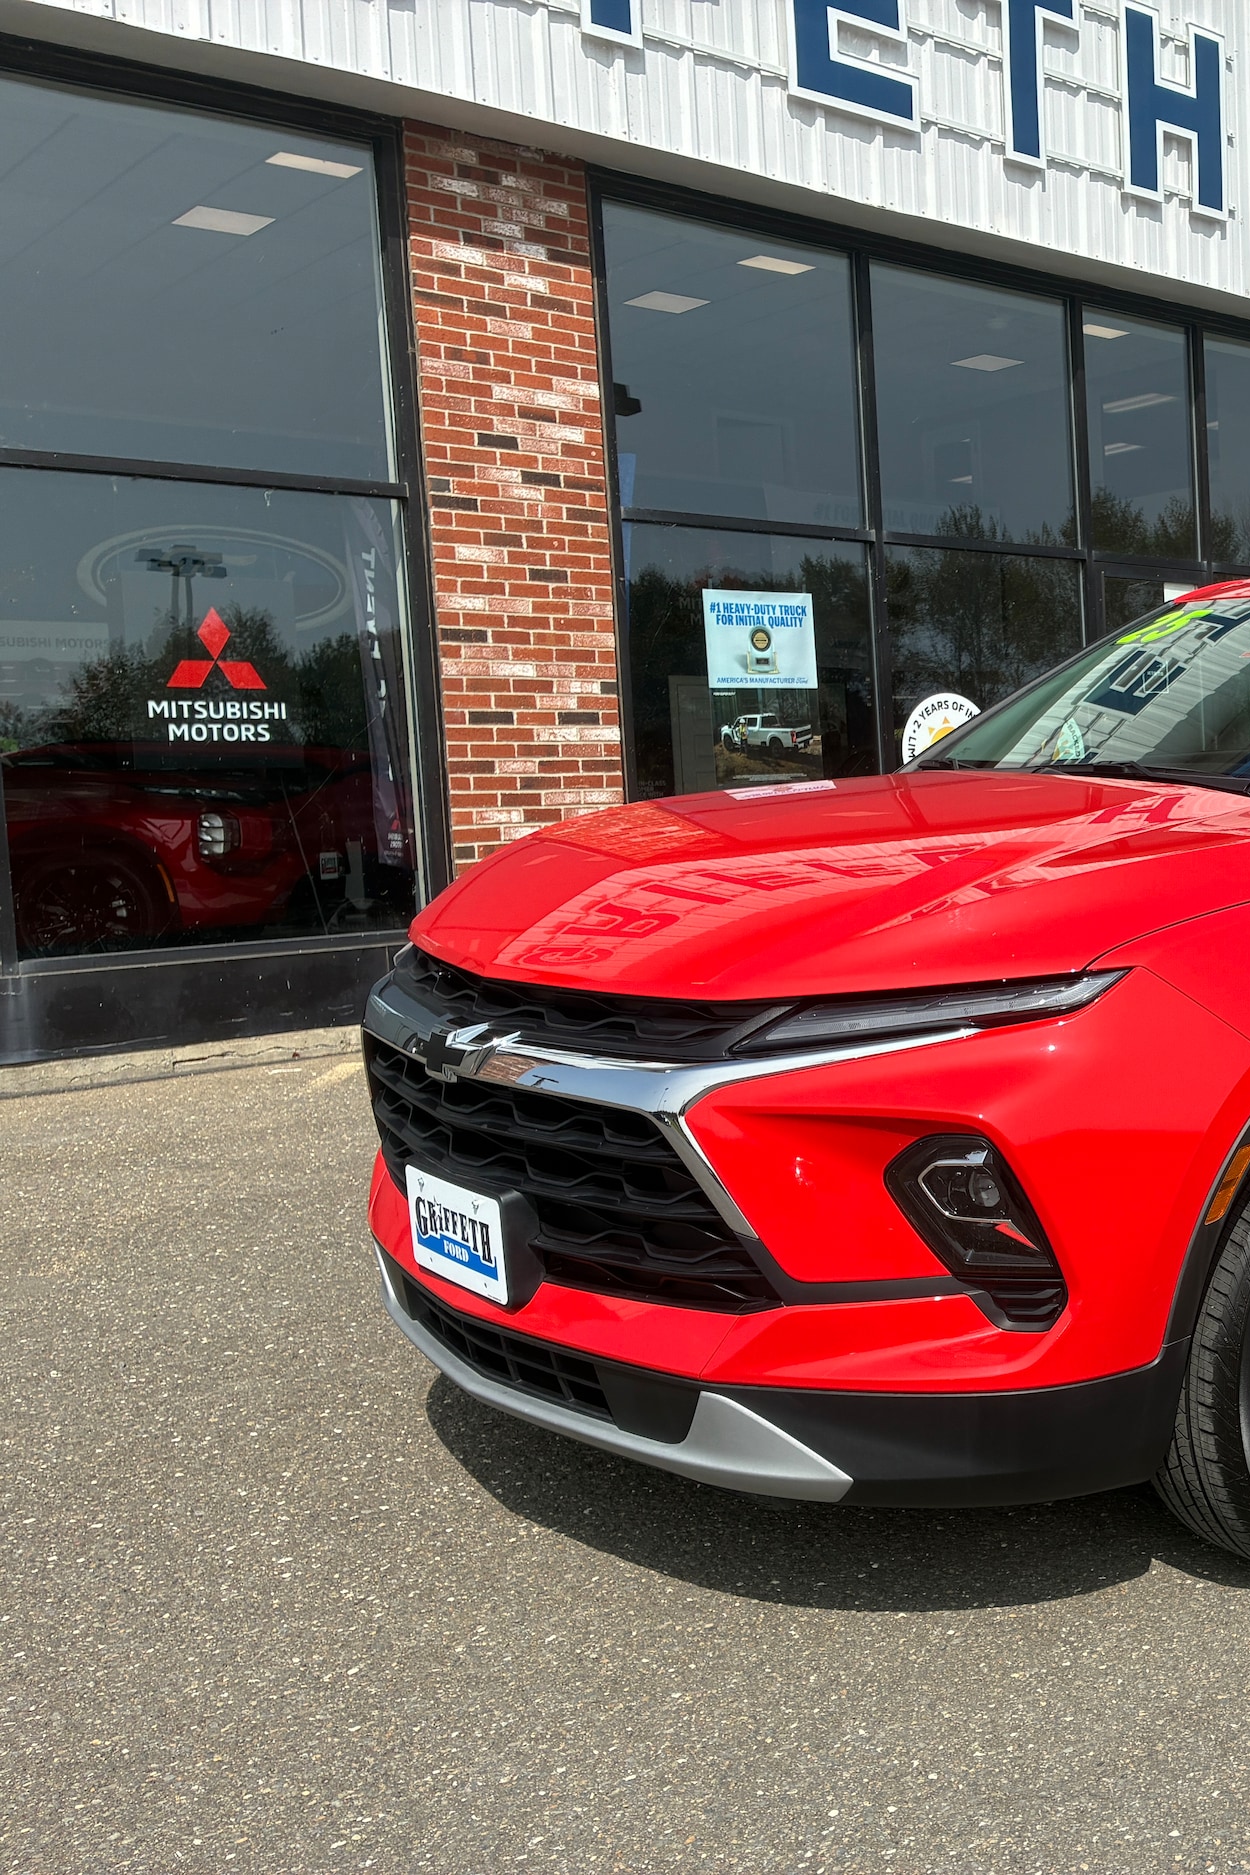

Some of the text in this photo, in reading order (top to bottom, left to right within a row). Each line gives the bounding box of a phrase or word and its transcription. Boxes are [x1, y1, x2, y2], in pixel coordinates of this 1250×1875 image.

[582, 0, 1227, 222] ETH
[710, 602, 721, 614] #1
[722, 603, 776, 616] HEAVY-DUTY
[779, 604, 807, 617] TRUCK
[716, 614, 803, 629] FOR INITIAL QUALITY
[717, 676, 748, 684] AMERICA'S
[749, 676, 795, 685] MANUFACTURER
[147, 700, 287, 720] MITSUBISHI
[913, 719, 922, 730] 2
[919, 700, 949, 720] YEARS
[952, 701, 965, 713] OF
[168, 723, 271, 742] MOTORS
[415, 1196, 493, 1265] GRIFFETH
[443, 1239, 470, 1263] FORD
